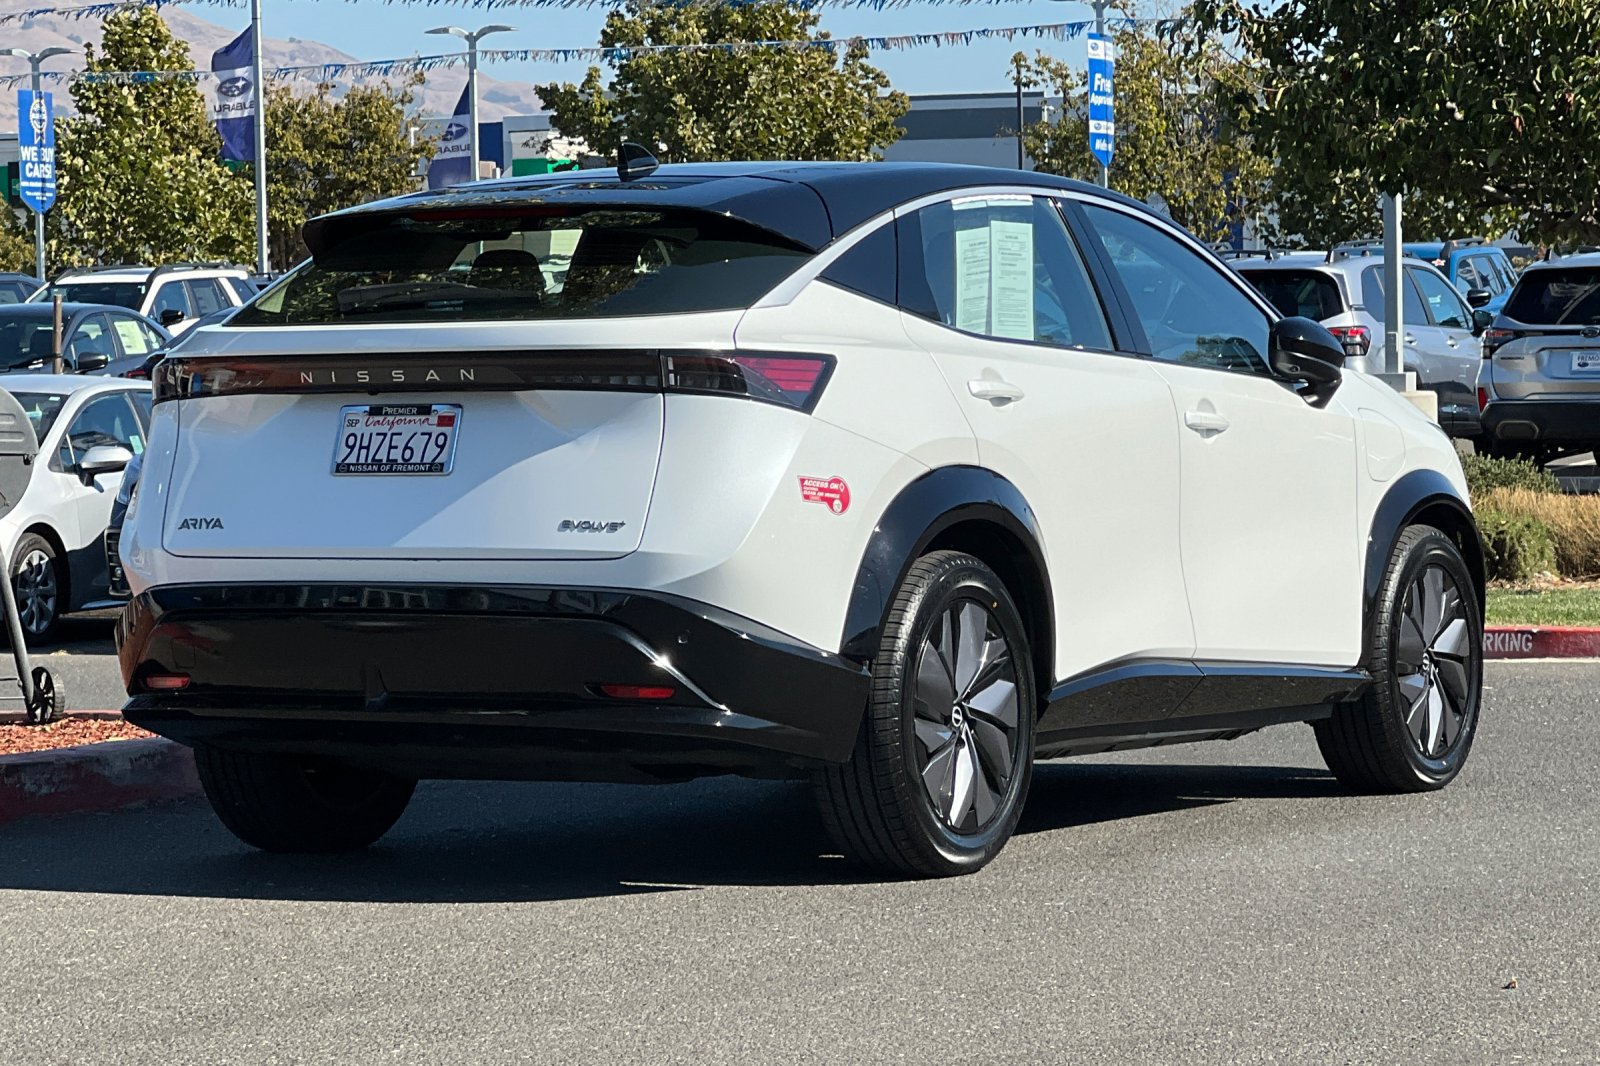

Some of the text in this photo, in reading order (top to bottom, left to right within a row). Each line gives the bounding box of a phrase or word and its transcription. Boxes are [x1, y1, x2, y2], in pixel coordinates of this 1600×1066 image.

[20, 146, 38, 161] WE
[300, 368, 475, 383] NISSAN
[346, 415, 437, 431] SEP California
[341, 431, 449, 464] 9HZE679
[349, 464, 430, 472] NISSAN OF FREMONT
[178, 517, 225, 530] ARIYA
[1482, 632, 1533, 652] RKING
